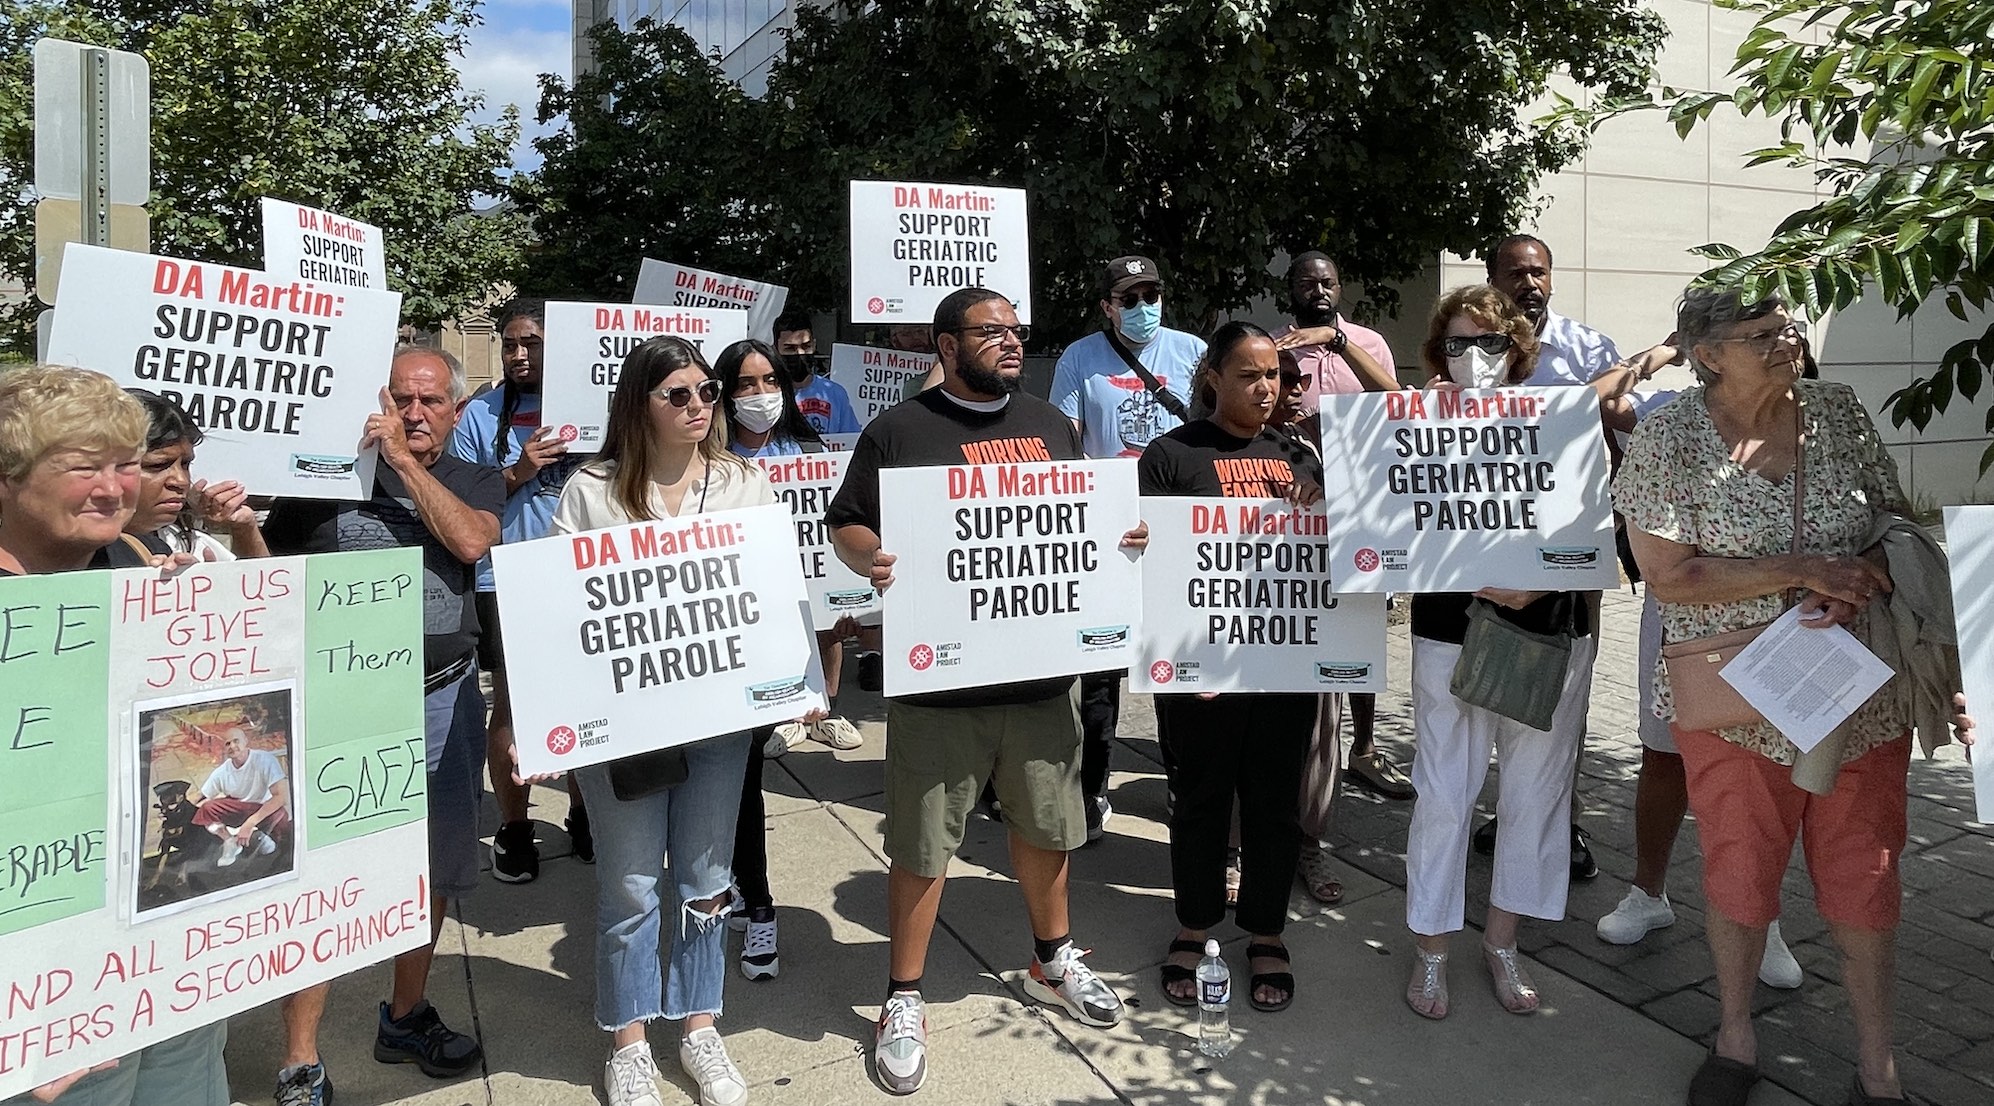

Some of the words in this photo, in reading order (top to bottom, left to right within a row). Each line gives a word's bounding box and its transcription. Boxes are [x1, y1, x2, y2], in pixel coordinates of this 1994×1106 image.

[894, 187, 921, 208] DA
[929, 188, 996, 211] Martin:
[298, 207, 318, 231] DA
[323, 213, 366, 243] Martin:
[900, 214, 991, 237] SUPPORT
[303, 234, 364, 267] SUPPORT
[893, 239, 998, 262] GERIATRIC
[153, 260, 203, 299] DA
[219, 270, 344, 317] Martin:
[300, 258, 370, 288] GERIATRIC
[675, 271, 697, 290] DA
[702, 277, 760, 302] Martin:
[909, 266, 985, 288] PAROLE
[154, 304, 331, 358] SUPPORT
[595, 308, 625, 331] DA
[634, 310, 711, 334] Martin:
[134, 345, 334, 398] GERIATRIC
[863, 351, 881, 366] DA
[887, 353, 931, 371] Martin
[858, 385, 902, 402] GERIA
[1386, 392, 1427, 420] DA
[1438, 390, 1546, 419] Martin:
[961, 437, 1051, 465] WORKING
[1394, 426, 1540, 458] SUPPORT
[948, 467, 988, 500] DA
[998, 464, 1094, 498] Martin:
[1213, 458, 1294, 482] WORKING
[1388, 462, 1556, 494] GERIATRIC
[955, 502, 1088, 541] SUPPORT
[1192, 505, 1228, 535] DA
[1240, 506, 1328, 536] Martin
[1414, 499, 1538, 531] PAROLE
[572, 533, 620, 571] DA
[630, 519, 745, 561] Martin:
[1197, 542, 1329, 573] SUPPORT
[947, 541, 1098, 582] GERIATRIC
[123, 576, 212, 624] HELP
[242, 569, 291, 600] US
[317, 573, 412, 612] KEEP
[584, 554, 742, 611] SUPPORT
[1188, 578, 1338, 610] GERIATRIC
[970, 581, 1080, 621] PAROLE
[167, 607, 267, 646] GIVE
[580, 591, 760, 656] GERIATRIC
[1209, 615, 1318, 645] PAROLE
[146, 646, 270, 687] JOEL
[316, 640, 412, 673] Them
[611, 635, 746, 694] PAROLE
[578, 718, 608, 732] AMISTAD
[579, 730, 593, 740] LAW
[580, 734, 609, 748] PROJECT
[317, 738, 424, 819] SAFE
[0, 830, 106, 898] RABLE
[0, 969, 73, 1020] ND
[94, 940, 164, 990] ALL
[185, 877, 365, 961] DESERVING
[130, 988, 153, 1032] A
[170, 940, 305, 1013] SECOND
[312, 874, 427, 963] CHANCE!
